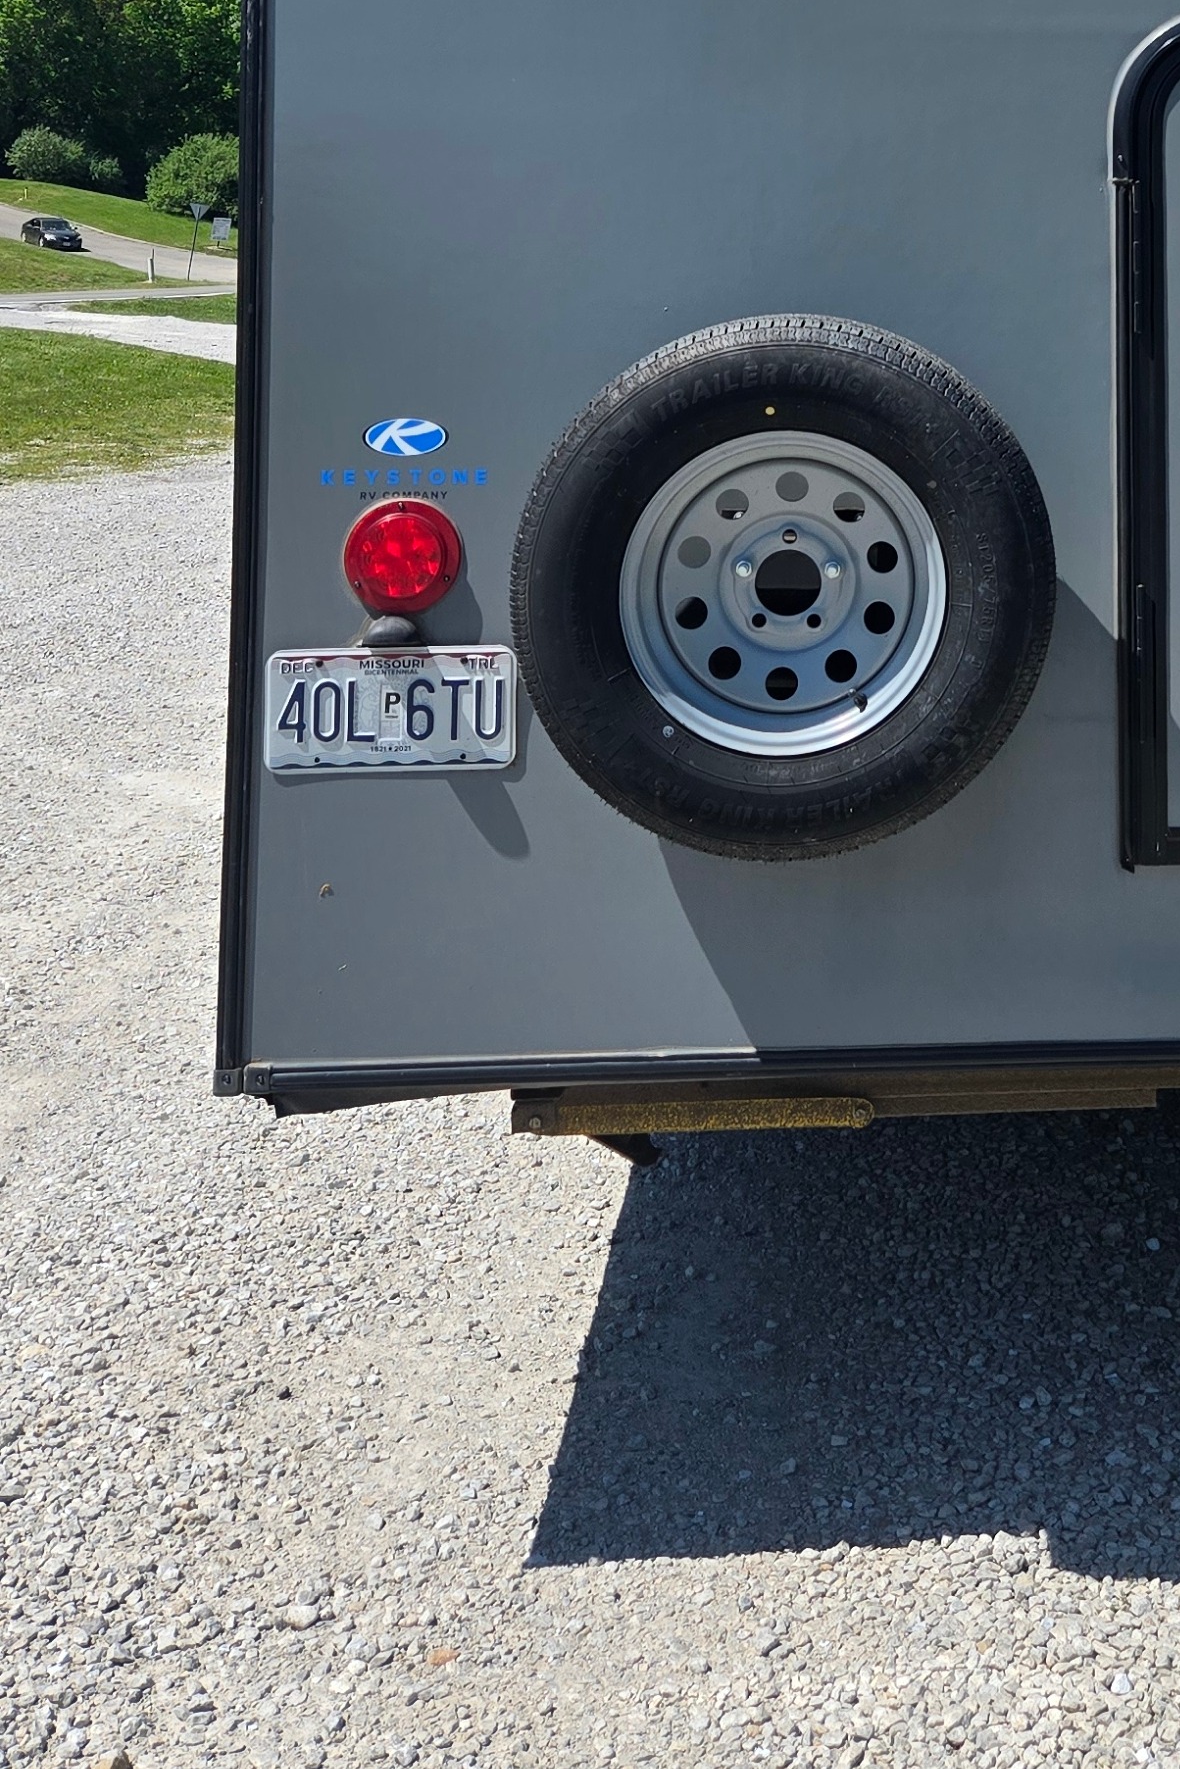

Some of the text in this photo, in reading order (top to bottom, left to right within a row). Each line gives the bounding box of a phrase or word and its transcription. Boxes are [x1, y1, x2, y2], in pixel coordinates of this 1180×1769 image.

[320, 468, 489, 487] KEYSTONE
[359, 490, 448, 501] RV COMPANY
[279, 660, 315, 675] DEC
[359, 658, 425, 670] MISSOURI
[468, 657, 500, 670] TRL
[364, 668, 419, 676] BICENTENNIAL
